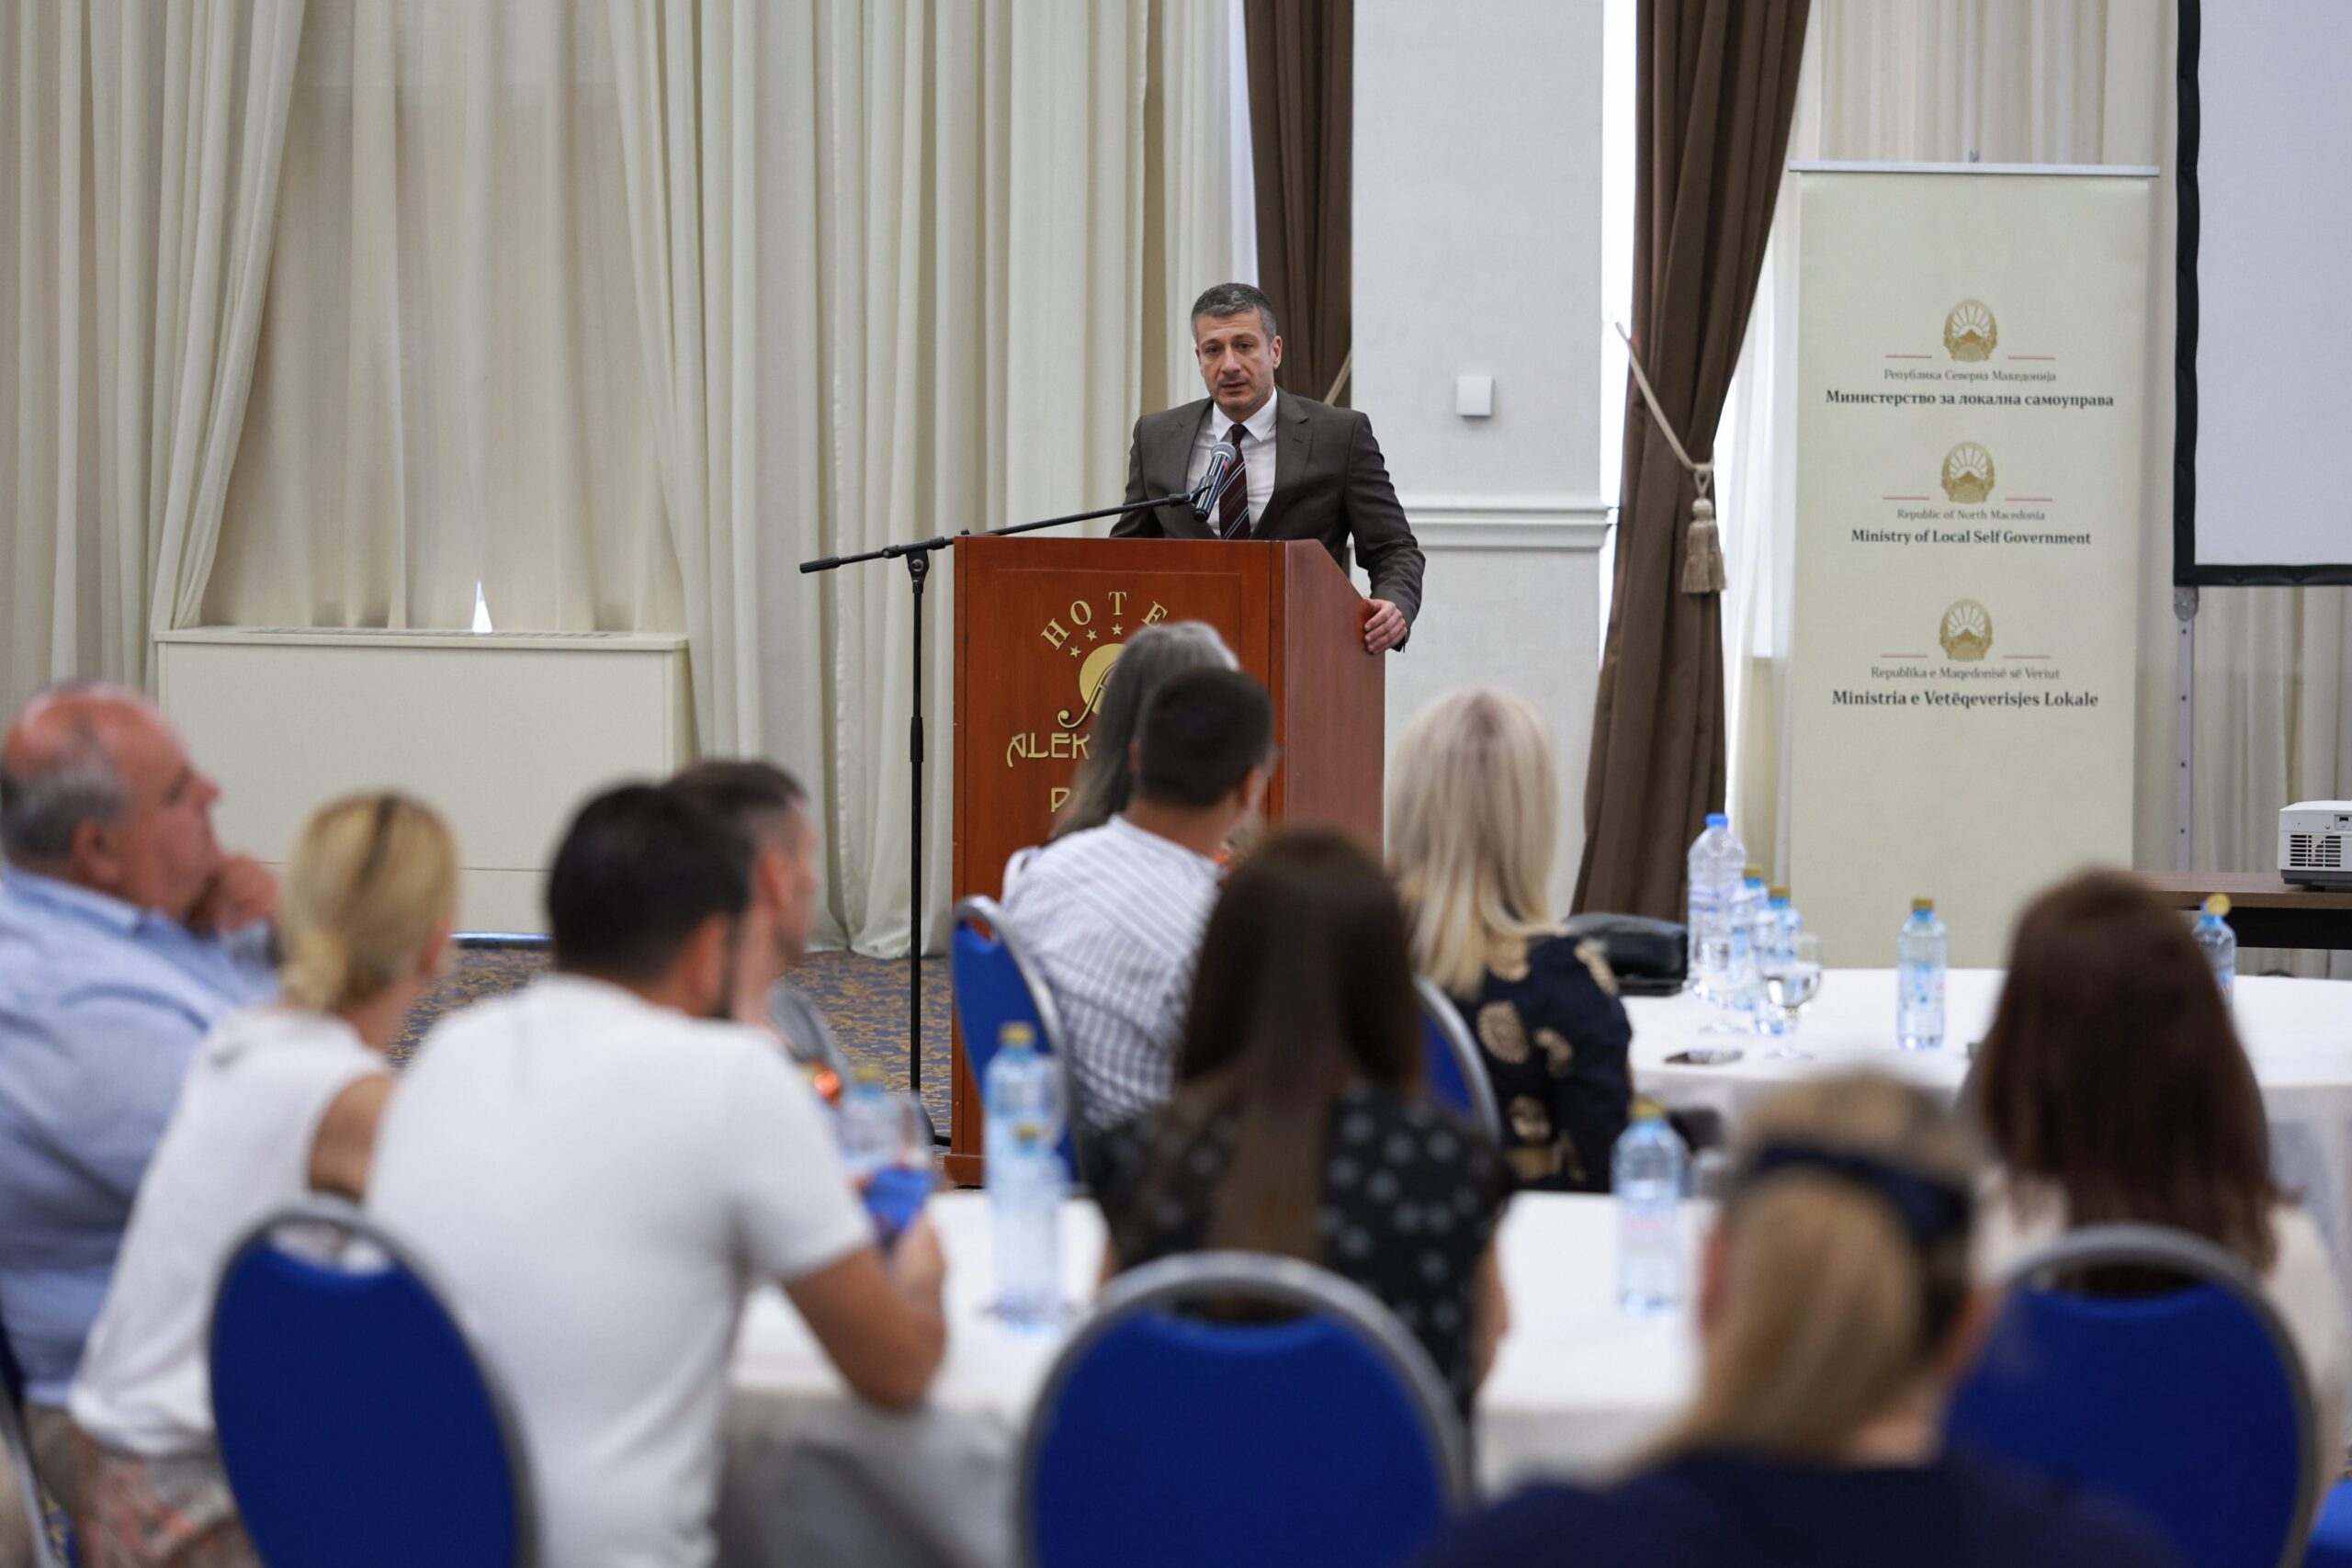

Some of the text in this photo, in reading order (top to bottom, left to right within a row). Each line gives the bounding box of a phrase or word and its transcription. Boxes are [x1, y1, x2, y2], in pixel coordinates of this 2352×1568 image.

[1884, 369, 2056, 382] Република Северна Македонија
[1826, 389, 2114, 409] Министерство за локална самоуправа
[1897, 510, 2045, 521] Republic of North Macedonia
[1851, 530, 2091, 546] Ministry of Local Self Government
[1041, 592, 1168, 650] HOTE
[1871, 667, 1927, 680] Republika
[1939, 668, 2007, 681] Maqedonisë
[2009, 669, 2021, 679] së
[2025, 669, 2059, 679] Veriut
[1832, 691, 2098, 708] Ministria e Vetëqeverisjes Lokale
